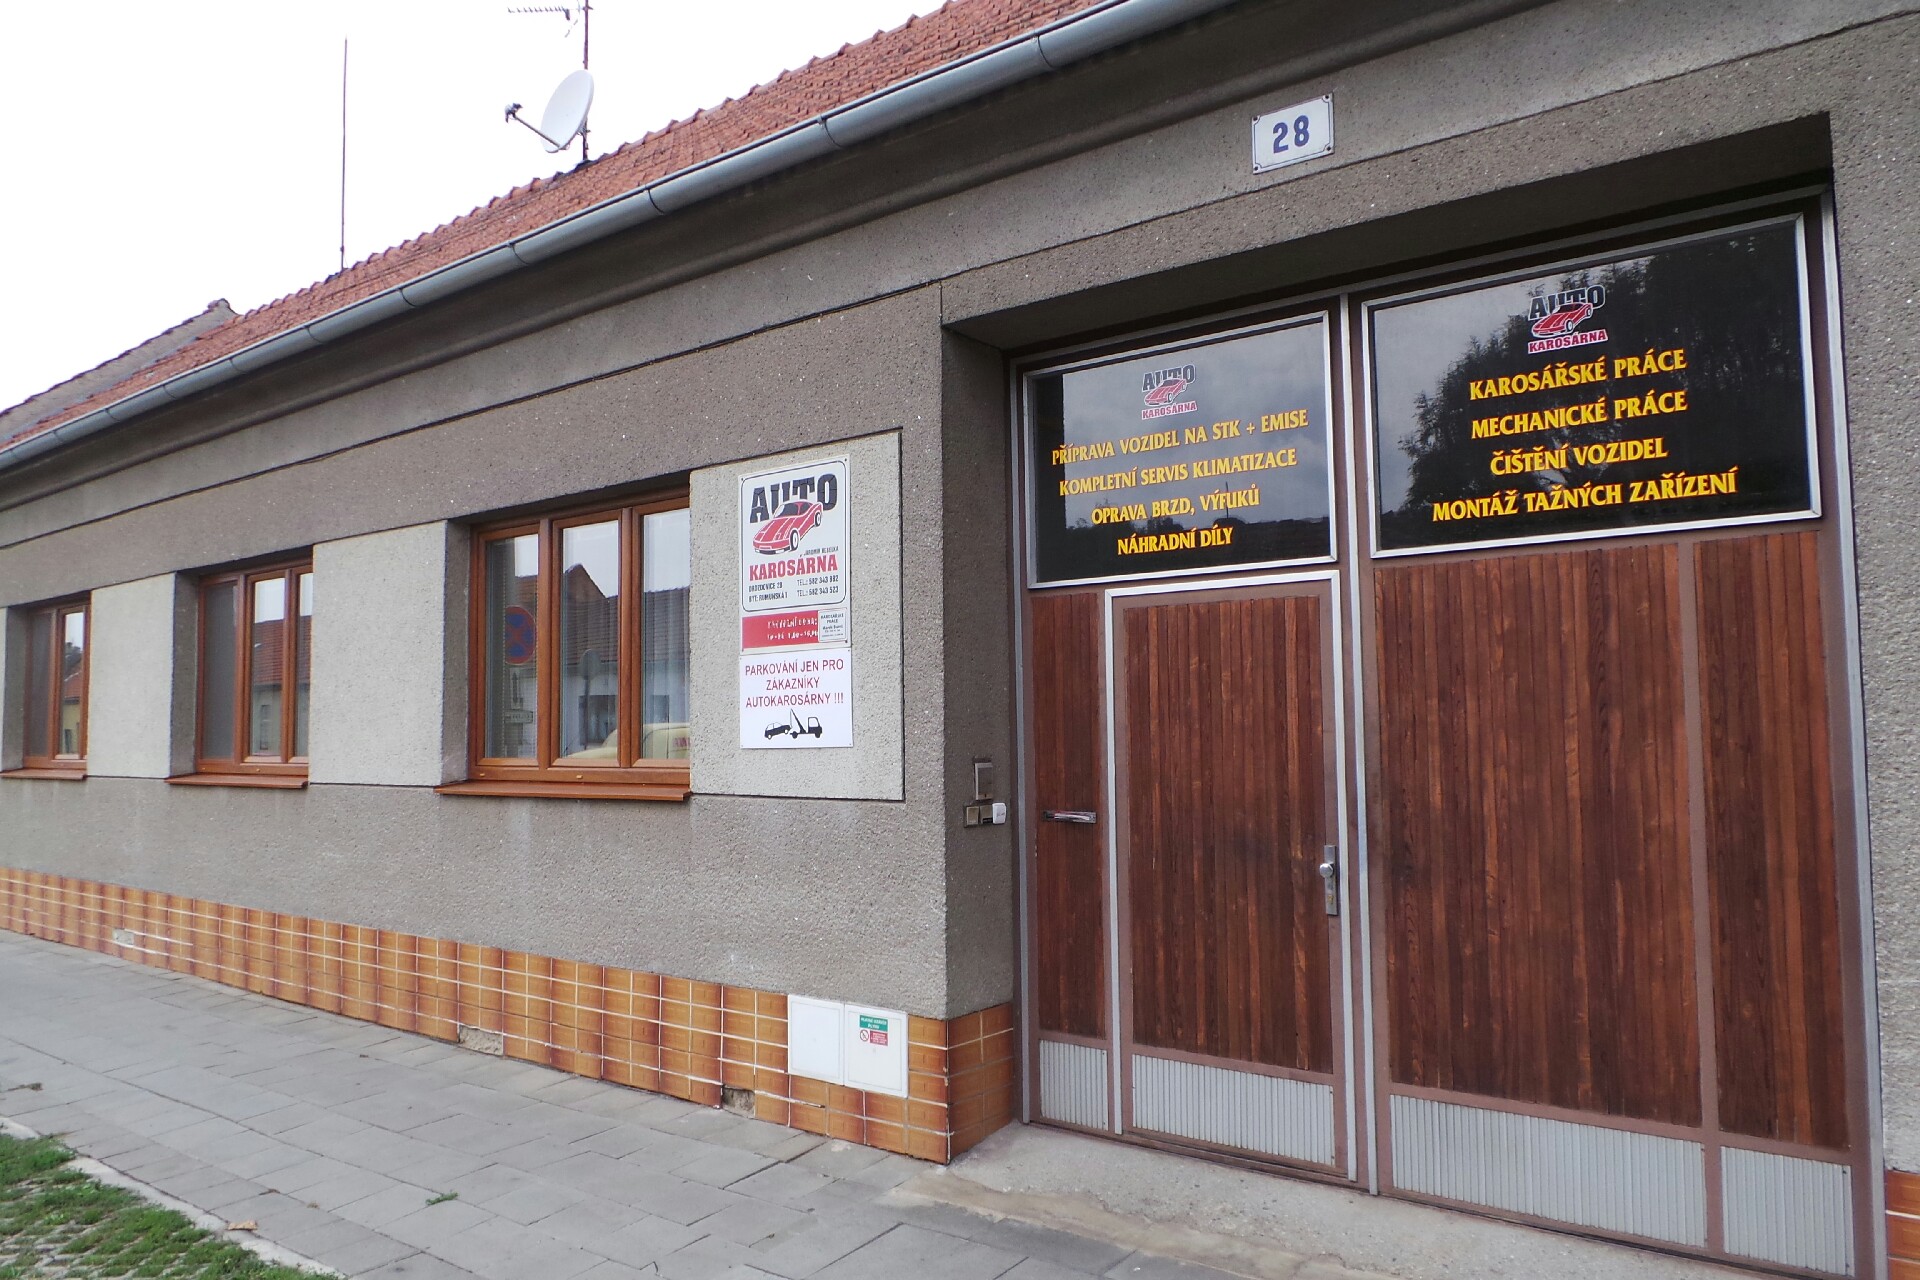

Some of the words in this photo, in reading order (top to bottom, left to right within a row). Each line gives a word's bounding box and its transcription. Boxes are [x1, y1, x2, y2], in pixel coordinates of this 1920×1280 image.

[1273, 115, 1309, 154] 28
[1529, 285, 1605, 320] AUTO
[1529, 329, 1608, 353] KAROSÁRNA
[1142, 364, 1196, 391] AUTO
[1469, 356, 1607, 400] KAROSÁŘSKÉ
[1614, 348, 1687, 379] PRÁCE
[1142, 401, 1197, 419] KAROSÁRNA
[1471, 397, 1607, 439] MECHANICKÉ
[1614, 390, 1687, 420] PRÁCE
[1052, 441, 1115, 465] PŘÍPRAVA
[1119, 431, 1180, 455] VOZIDEL
[1184, 426, 1208, 445] NA
[1212, 420, 1240, 440] STK
[1246, 423, 1256, 435] +
[1261, 409, 1308, 433] EMISE
[1059, 467, 1137, 496] KOMPLETNÍ
[1140, 463, 1188, 485] SERVIS
[1193, 449, 1297, 479] KLIMATIZACE
[1490, 444, 1567, 475] ČIŠTĚNÍ
[1573, 437, 1668, 467] VOZIDEL
[750, 473, 837, 523] AUTO
[1091, 505, 1147, 526] OPRAVA
[1152, 497, 1195, 518] BRZD,
[1200, 484, 1260, 512] VÝFUKŮ
[1432, 490, 1518, 522] MONTÁŽ
[1524, 481, 1622, 513] TAŽNÝCH
[1629, 466, 1738, 503] ZAŘÍZENÍ
[1117, 527, 1197, 555] NÁHRADNÍ
[1200, 524, 1233, 548] DÍLY
[750, 554, 838, 581] KAROSÁRNA
[745, 659, 798, 676] PARKOVÁNÍ
[800, 660, 819, 672] JEN
[822, 658, 844, 671] PRO
[766, 675, 820, 691] ZÁKAZNÍKY
[746, 691, 831, 708] AUTOKAROSÁRNY
